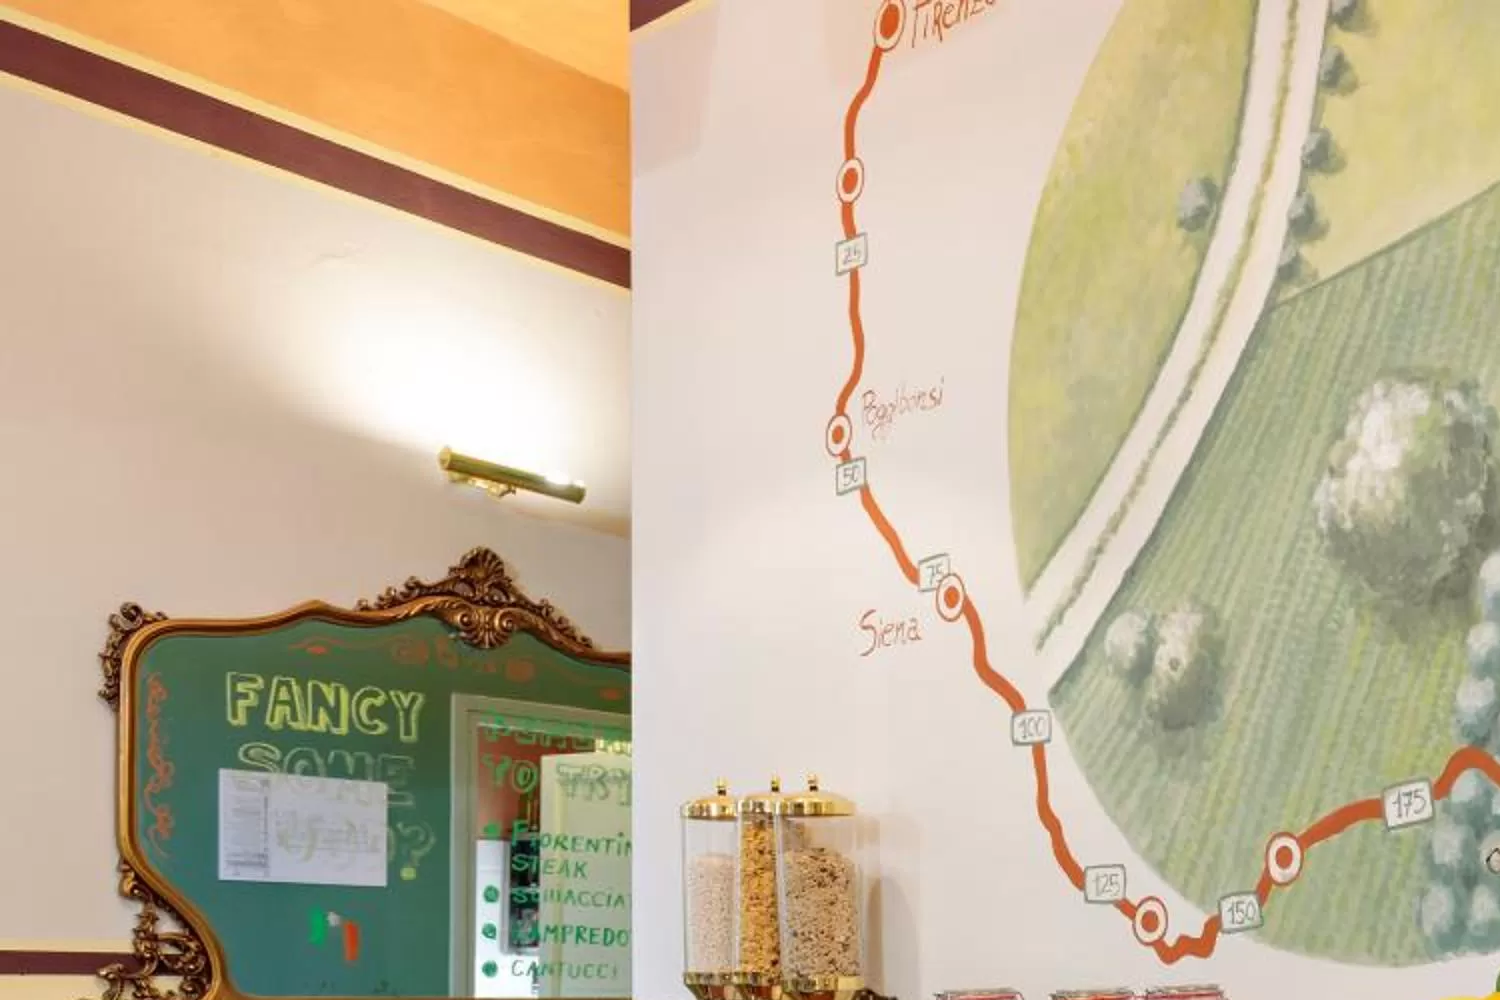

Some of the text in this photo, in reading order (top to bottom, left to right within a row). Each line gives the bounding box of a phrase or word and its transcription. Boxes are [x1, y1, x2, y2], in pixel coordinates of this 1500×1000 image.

[842, 464, 860, 487] 50
[859, 609, 922, 656] Siena
[226, 672, 425, 742] FANCY
[1017, 714, 1046, 740] 100
[1391, 788, 1427, 817] 175
[511, 854, 589, 879] STEAK
[1091, 870, 1122, 897] 125
[1226, 899, 1257, 926] 150
